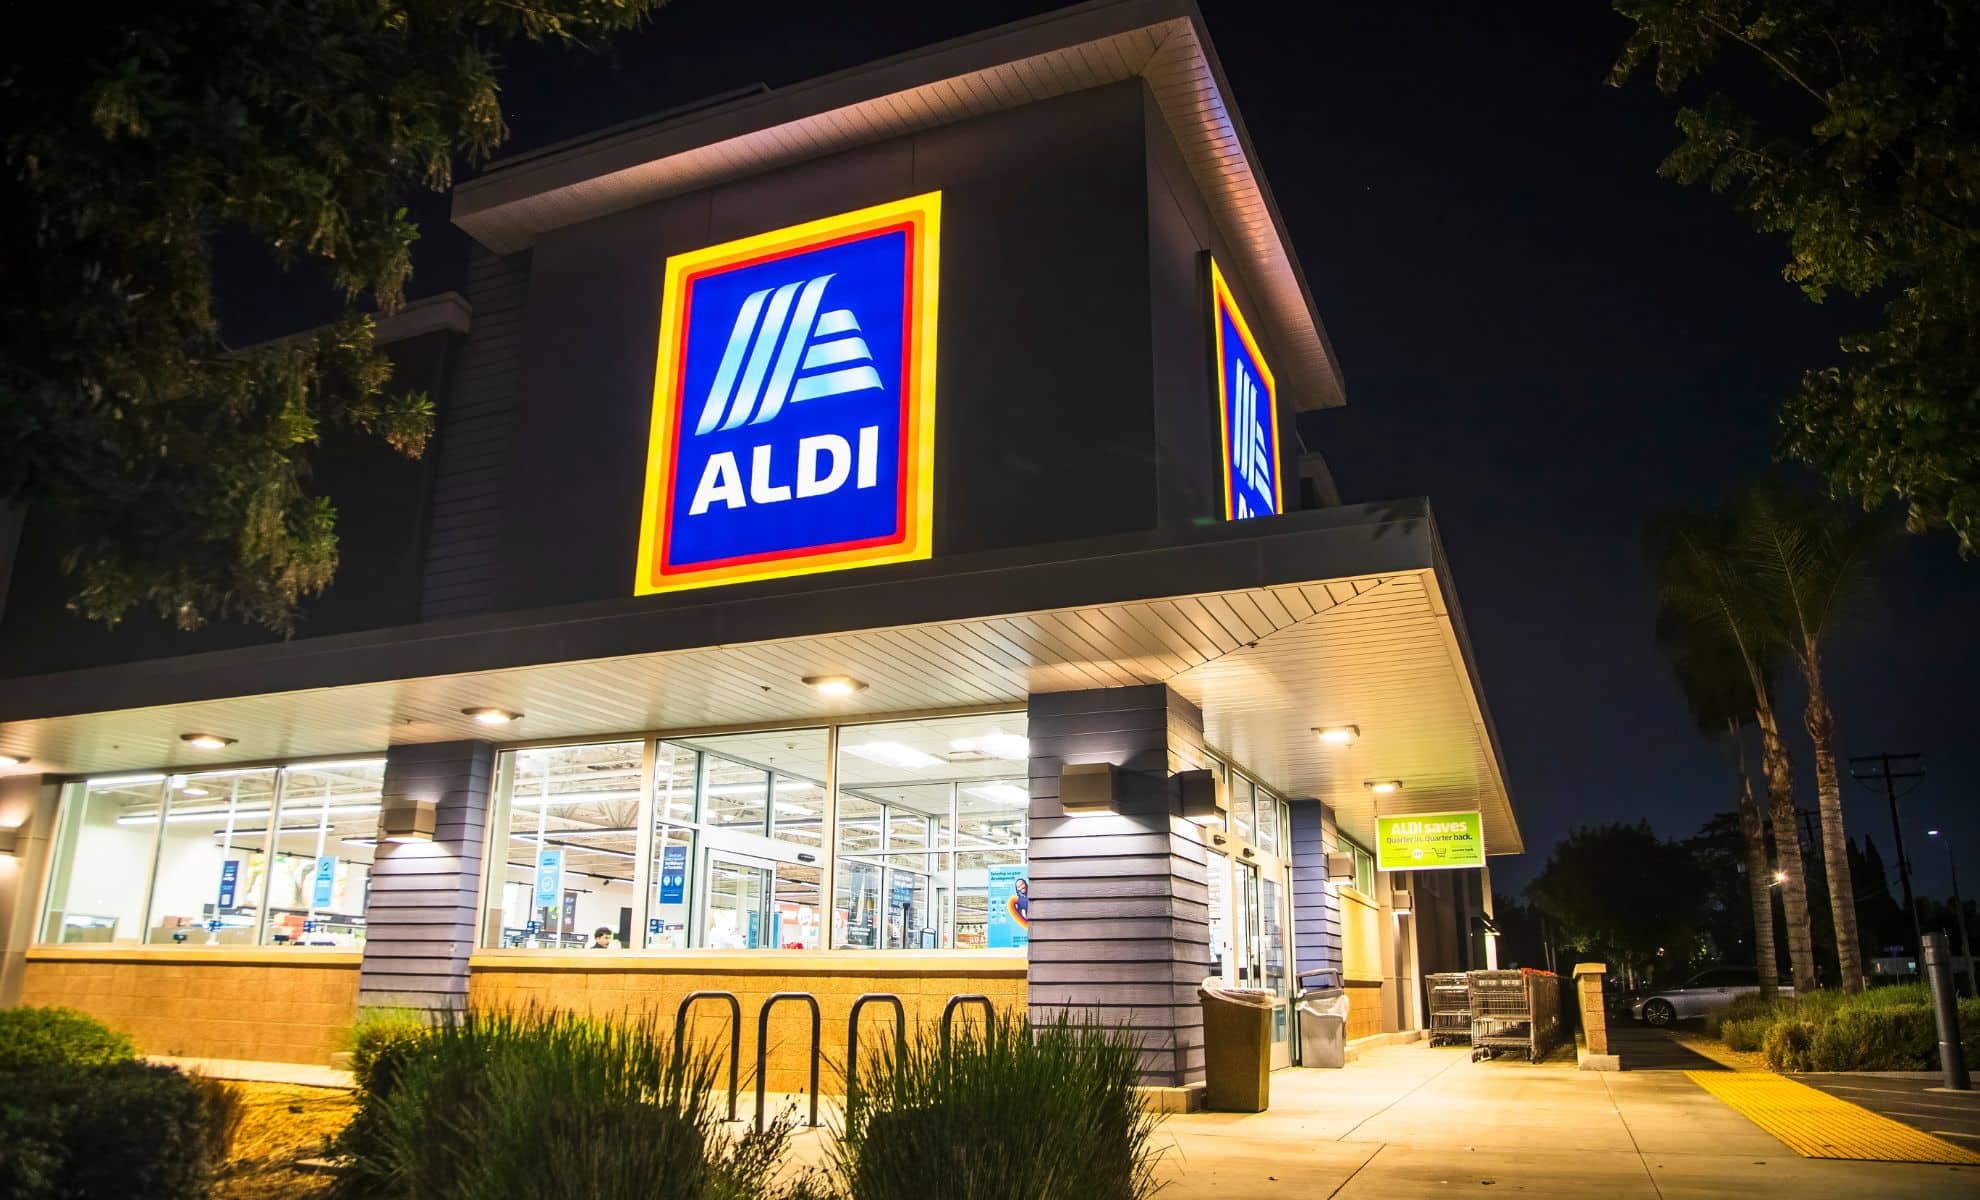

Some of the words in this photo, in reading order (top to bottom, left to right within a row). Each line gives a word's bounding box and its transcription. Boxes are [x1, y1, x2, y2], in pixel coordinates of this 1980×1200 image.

[688, 425, 879, 516] ALDI
[1391, 822, 1422, 835] ALDI
[1424, 821, 1467, 833] saves
[1386, 836, 1414, 845] Quarter
